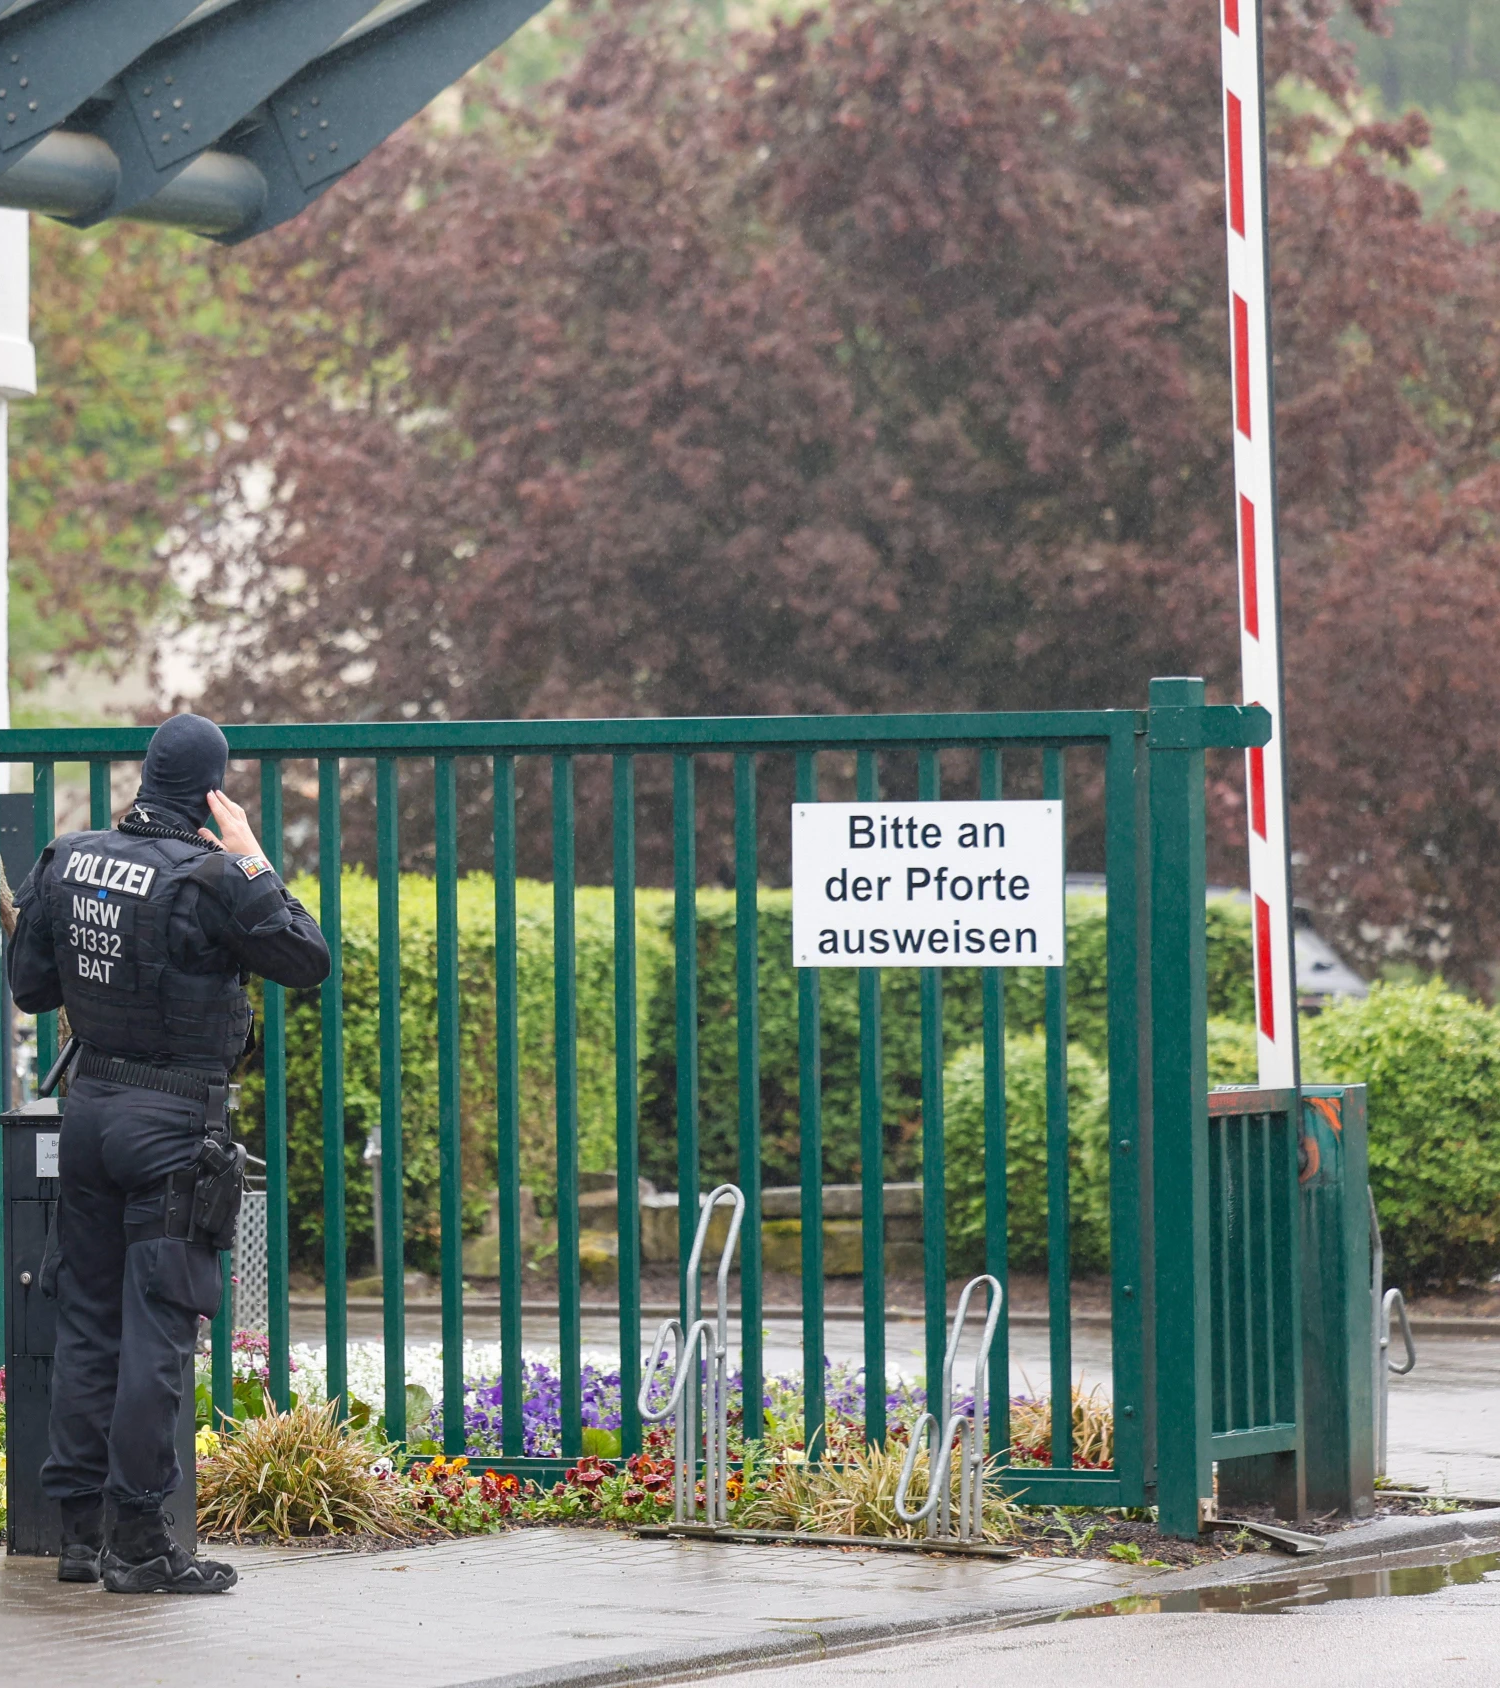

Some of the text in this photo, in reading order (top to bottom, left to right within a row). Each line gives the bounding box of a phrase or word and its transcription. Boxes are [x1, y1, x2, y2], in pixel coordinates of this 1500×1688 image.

[848, 814, 1006, 849] Bitte an
[63, 850, 156, 897] POLIZEI
[825, 866, 1031, 902] der Pforte
[72, 894, 122, 929] NRW
[68, 923, 123, 959] 31332
[817, 919, 1038, 954] ausweisen
[77, 953, 115, 985] BAT
